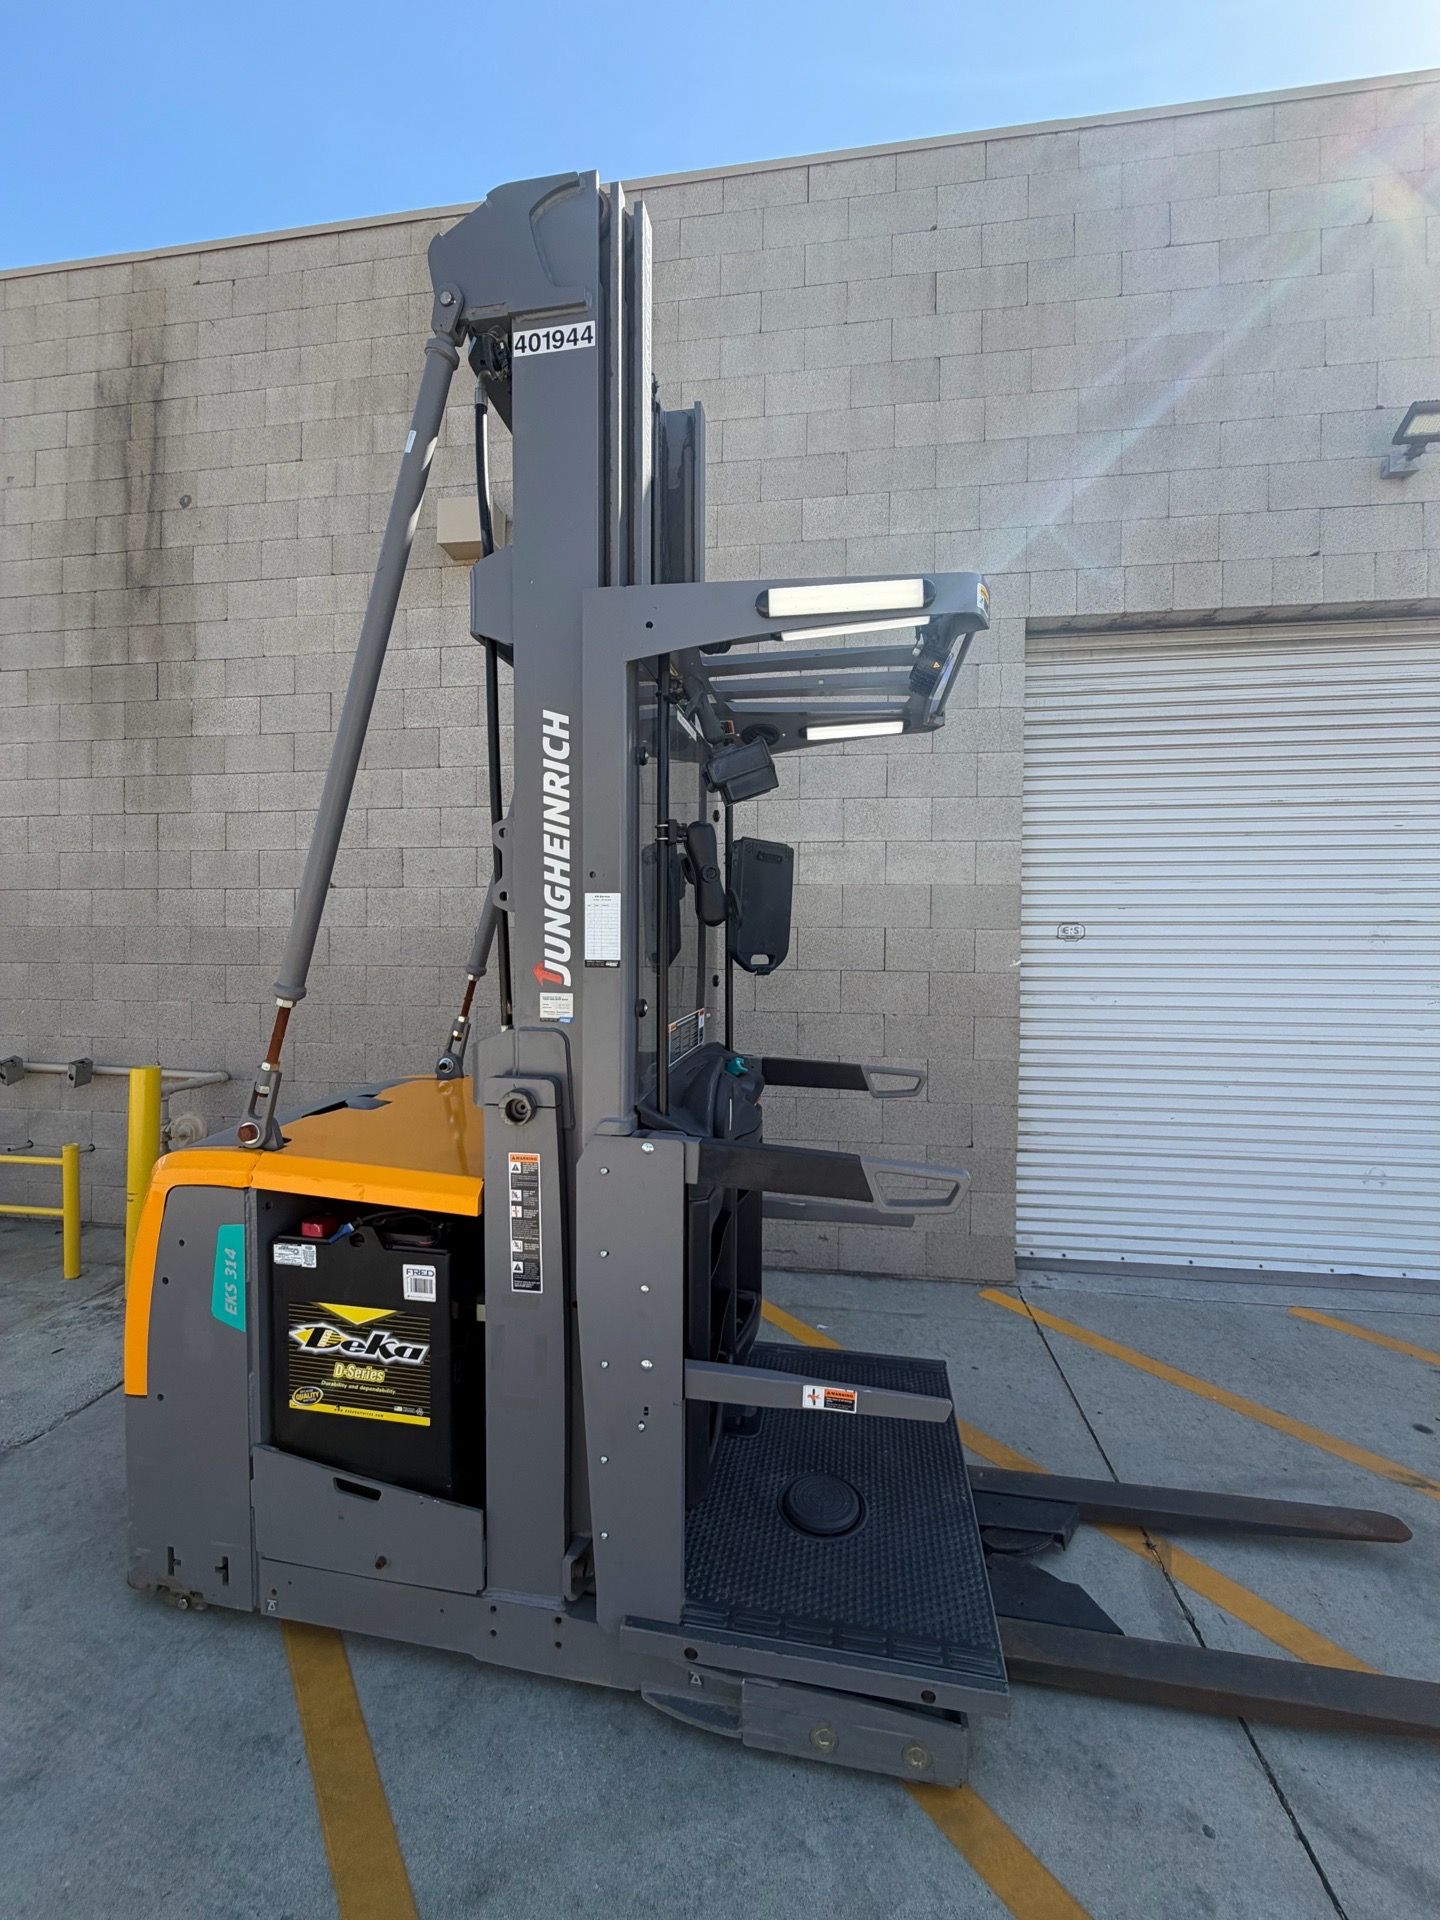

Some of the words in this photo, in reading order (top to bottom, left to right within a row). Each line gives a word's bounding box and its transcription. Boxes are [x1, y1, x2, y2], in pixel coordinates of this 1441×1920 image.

[514, 324, 594, 354] 401944
[540, 709, 571, 987] JUNGHEINRICH
[224, 1247, 238, 1280] 314
[406, 1268, 435, 1278] FRED
[224, 1282, 238, 1316] EKS
[291, 1325, 427, 1361] Deka
[320, 1380, 348, 1390] Durability
[333, 1362, 386, 1383] D-Series
[295, 1391, 321, 1401] QUALITY
